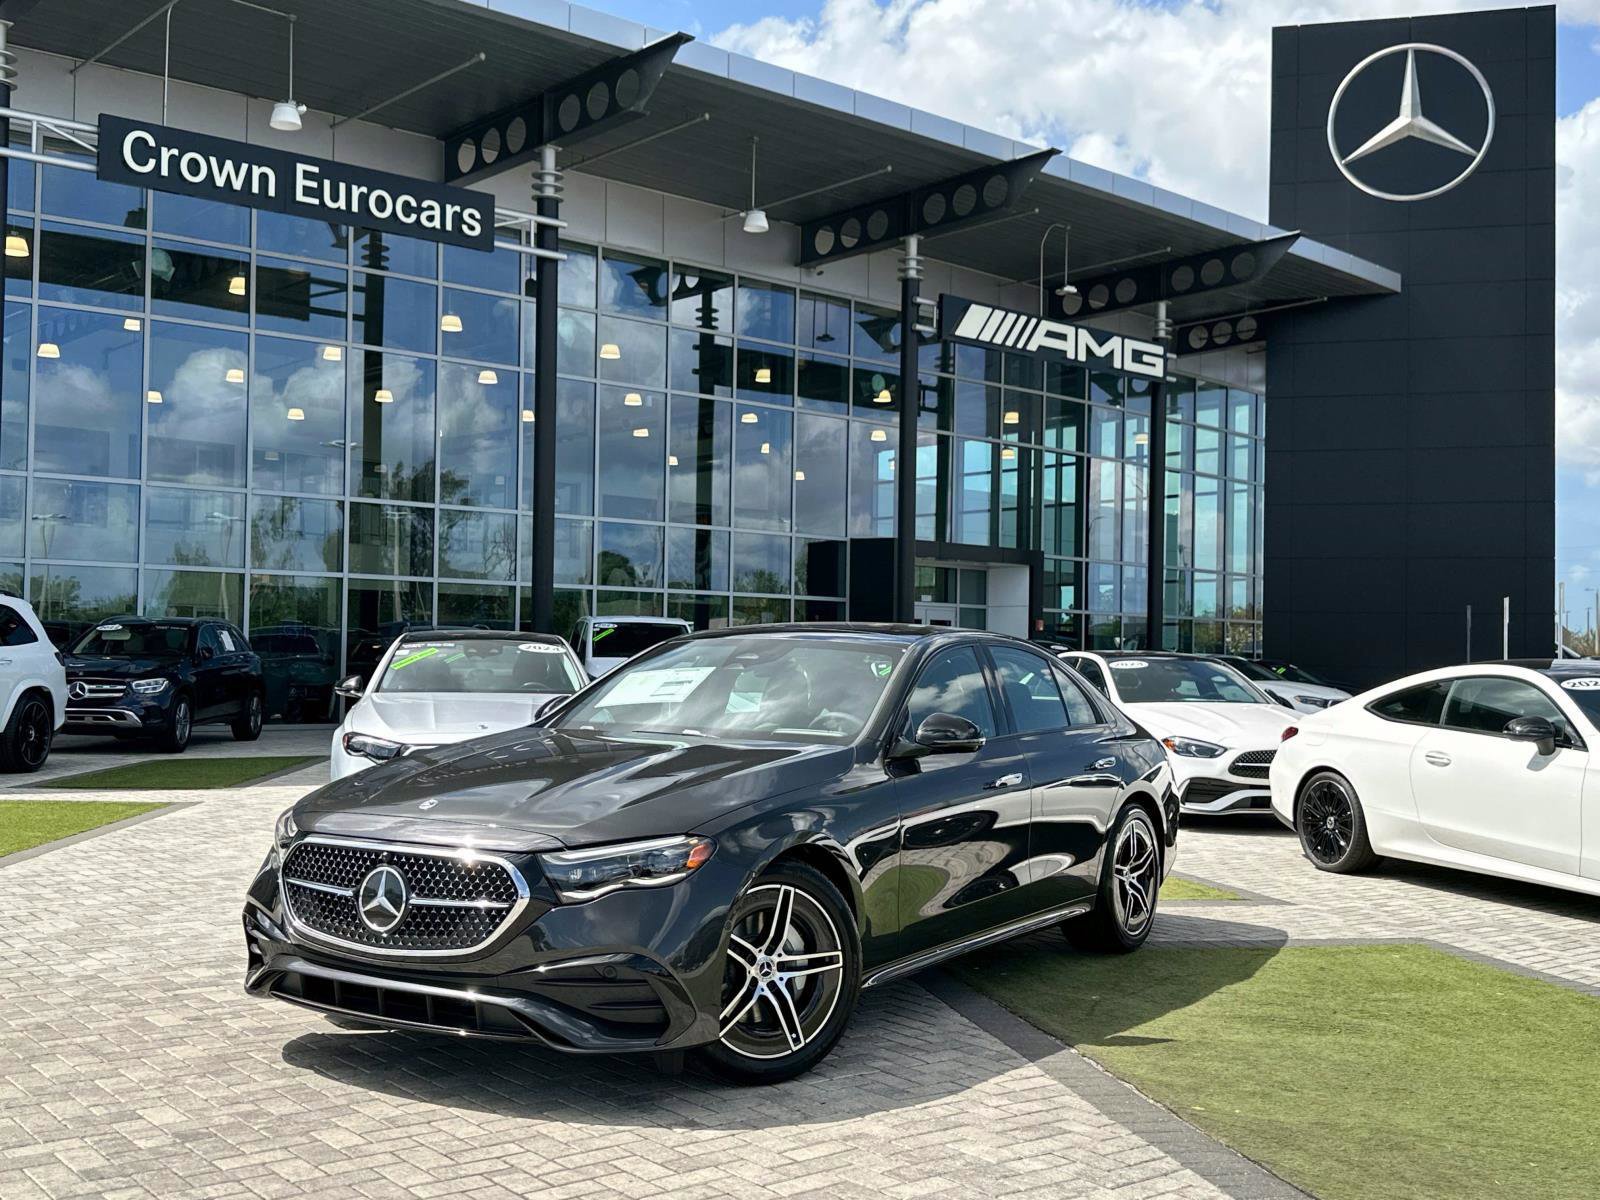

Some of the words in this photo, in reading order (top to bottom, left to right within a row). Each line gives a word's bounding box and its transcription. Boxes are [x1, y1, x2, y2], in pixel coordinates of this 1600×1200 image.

[122, 130, 276, 198] Crown
[295, 163, 482, 237] Eurocars
[1026, 319, 1164, 378] AMG
